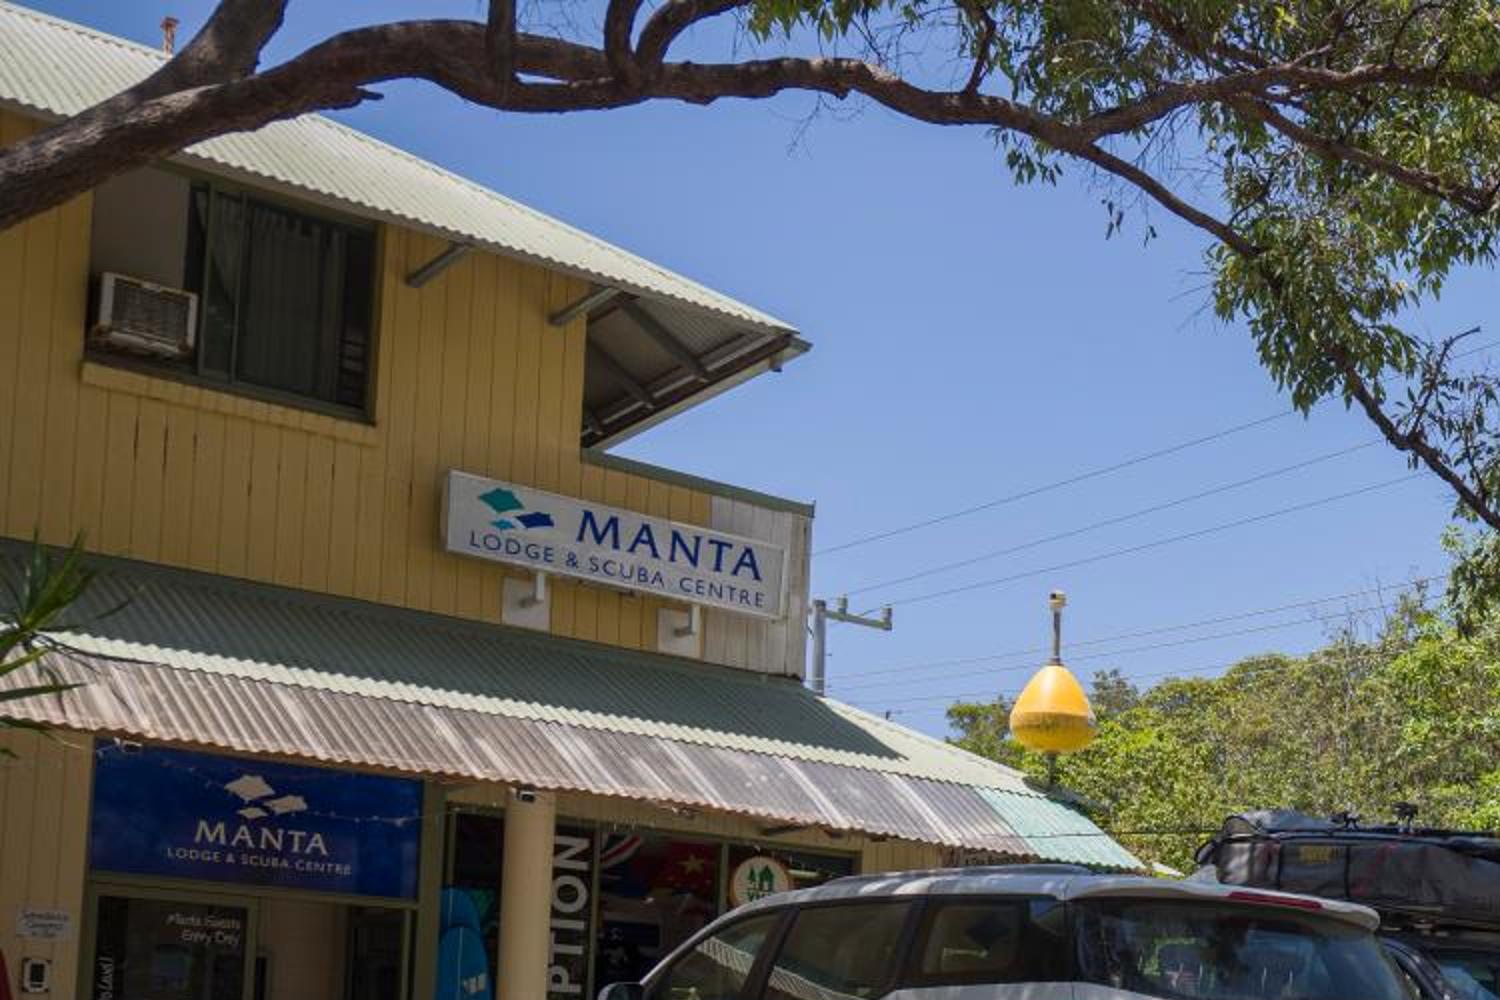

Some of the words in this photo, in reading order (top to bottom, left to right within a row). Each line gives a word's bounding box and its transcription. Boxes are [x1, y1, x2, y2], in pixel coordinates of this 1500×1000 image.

[469, 531, 554, 563] LODGE
[565, 552, 580, 568] &
[589, 556, 665, 587] SCUBA
[679, 577, 765, 607] CENTRE
[576, 510, 762, 581] MANTA
[167, 848, 220, 863] LODGE
[240, 854, 289, 869] SCUBA
[295, 859, 352, 875] CENTRE
[194, 820, 328, 856] MANTA
